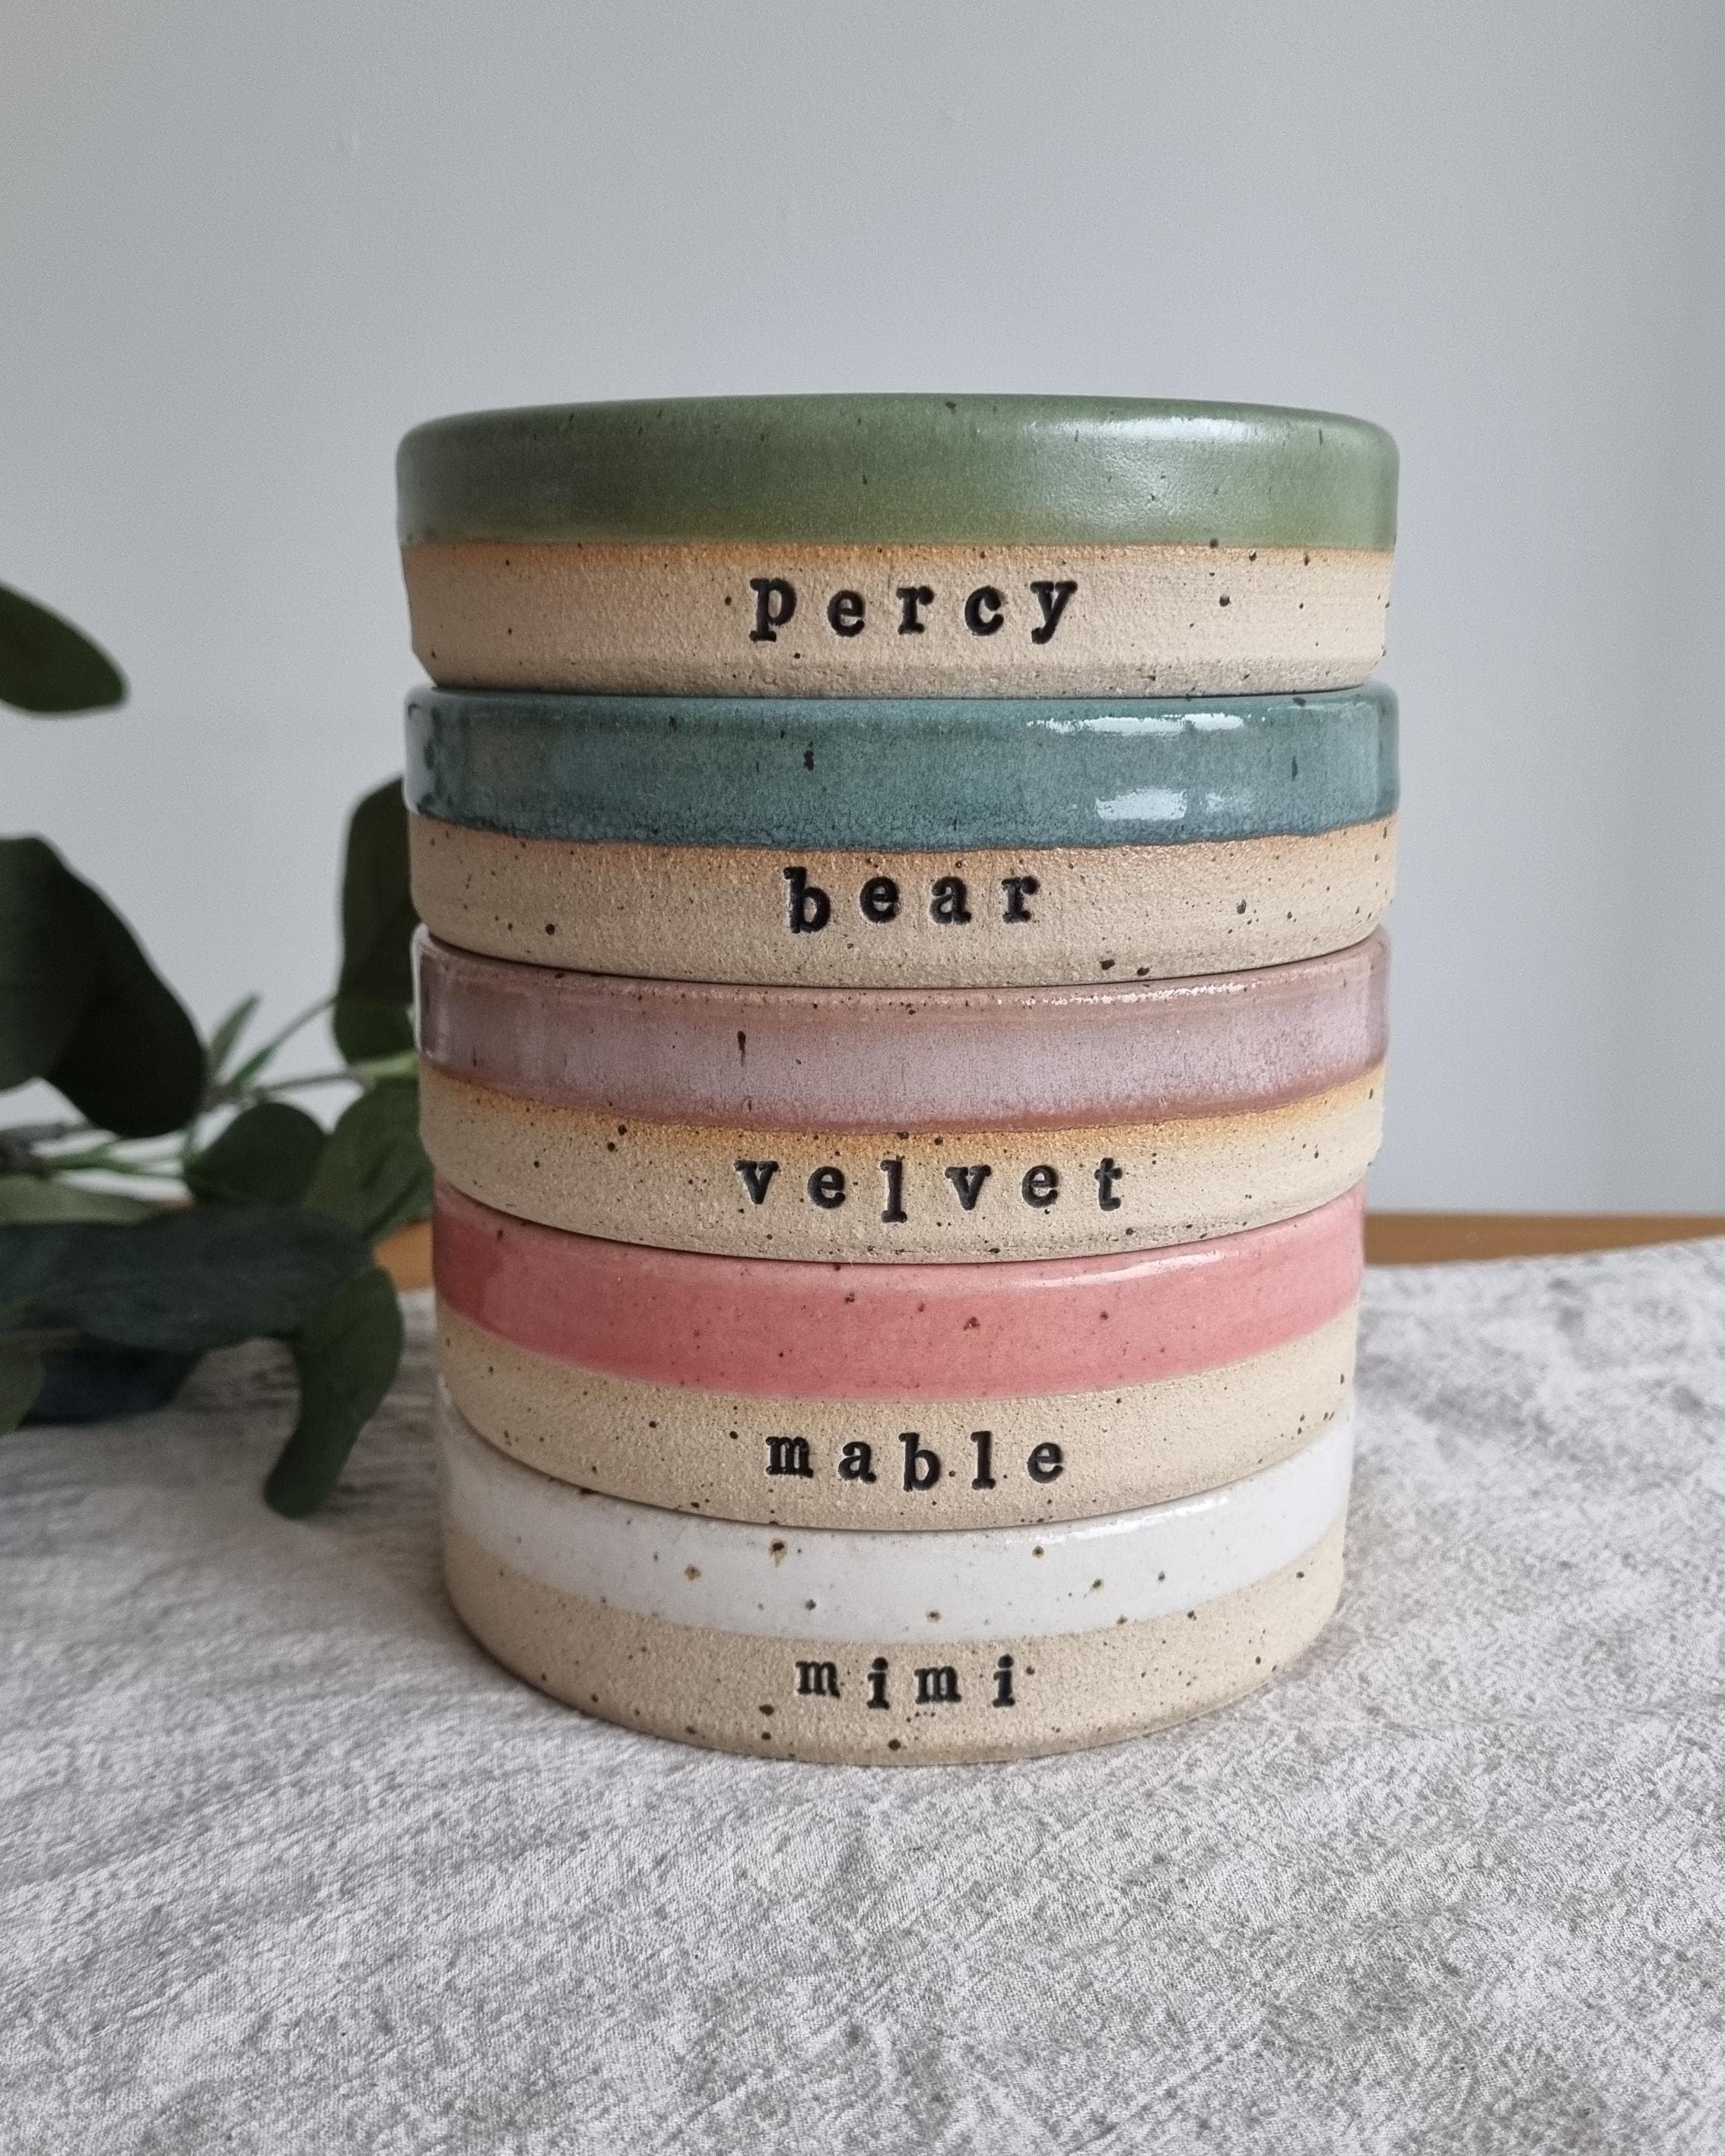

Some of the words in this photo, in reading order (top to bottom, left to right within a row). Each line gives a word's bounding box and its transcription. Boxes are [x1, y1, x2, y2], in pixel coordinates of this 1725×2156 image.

[748, 577, 1078, 644] percy
[783, 865, 1040, 934] bear
[734, 1156, 1123, 1223] velvet
[765, 1430, 1063, 1492] mable
[796, 1655, 1016, 1709] mimi
